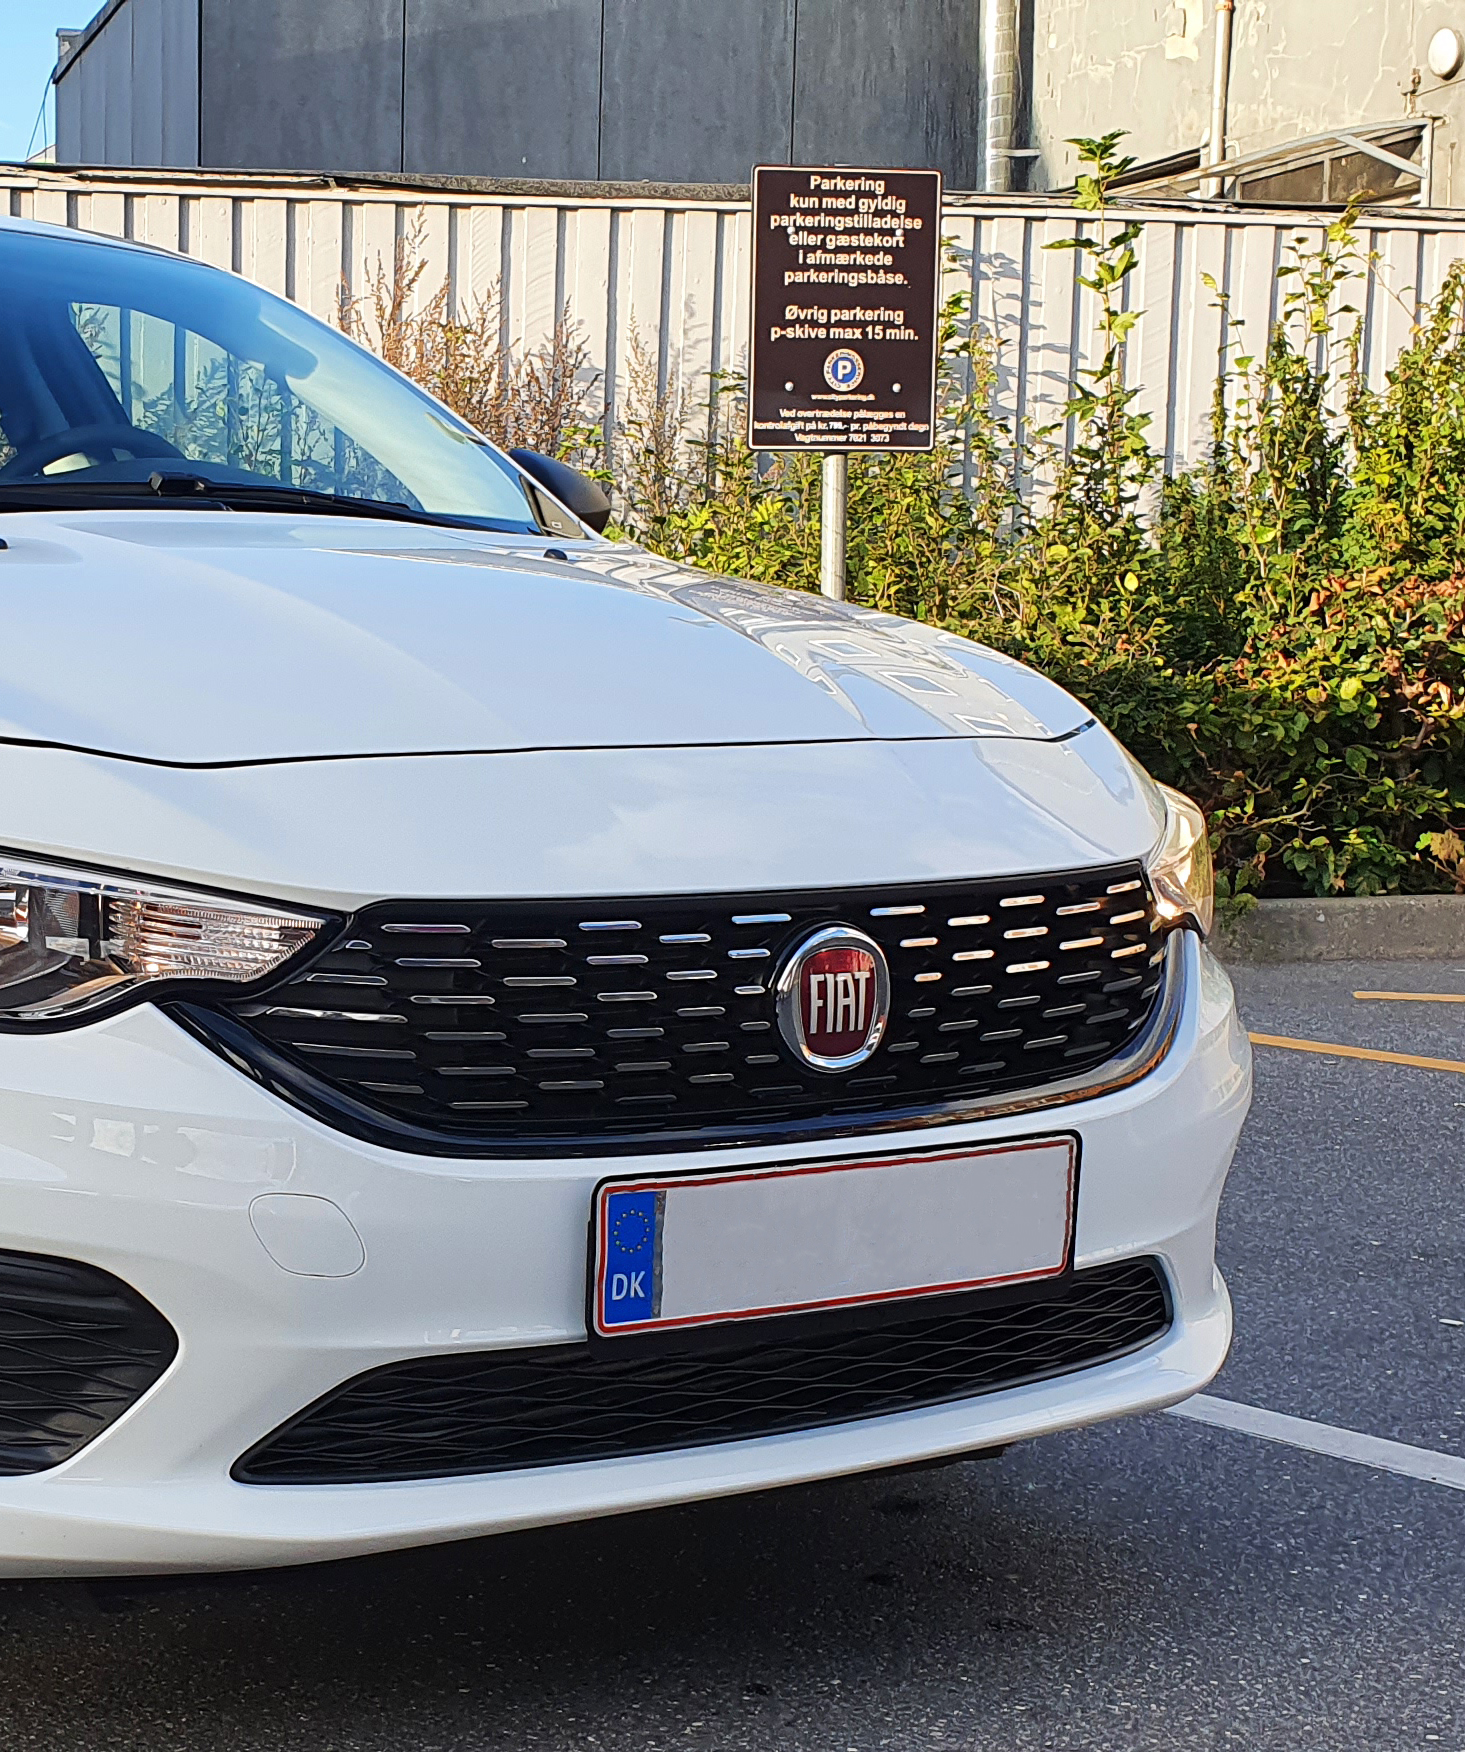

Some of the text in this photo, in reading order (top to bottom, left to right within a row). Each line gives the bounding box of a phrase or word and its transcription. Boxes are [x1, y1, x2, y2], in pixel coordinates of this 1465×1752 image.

[810, 175, 885, 194] Parkering
[789, 193, 906, 213] kun med gyldig
[770, 212, 922, 230] parkeringstilladelse
[789, 231, 905, 249] eller gæstekort
[798, 250, 893, 266] i afmærkede
[784, 269, 908, 287] parkeringsbåse.
[785, 305, 904, 324] Øvrig parkering
[770, 324, 919, 341] p-skive max 15 min.
[779, 408, 796, 418] Ved
[806, 421, 816, 431] på
[809, 971, 871, 1035] FIAT
[611, 1270, 646, 1301] DK
